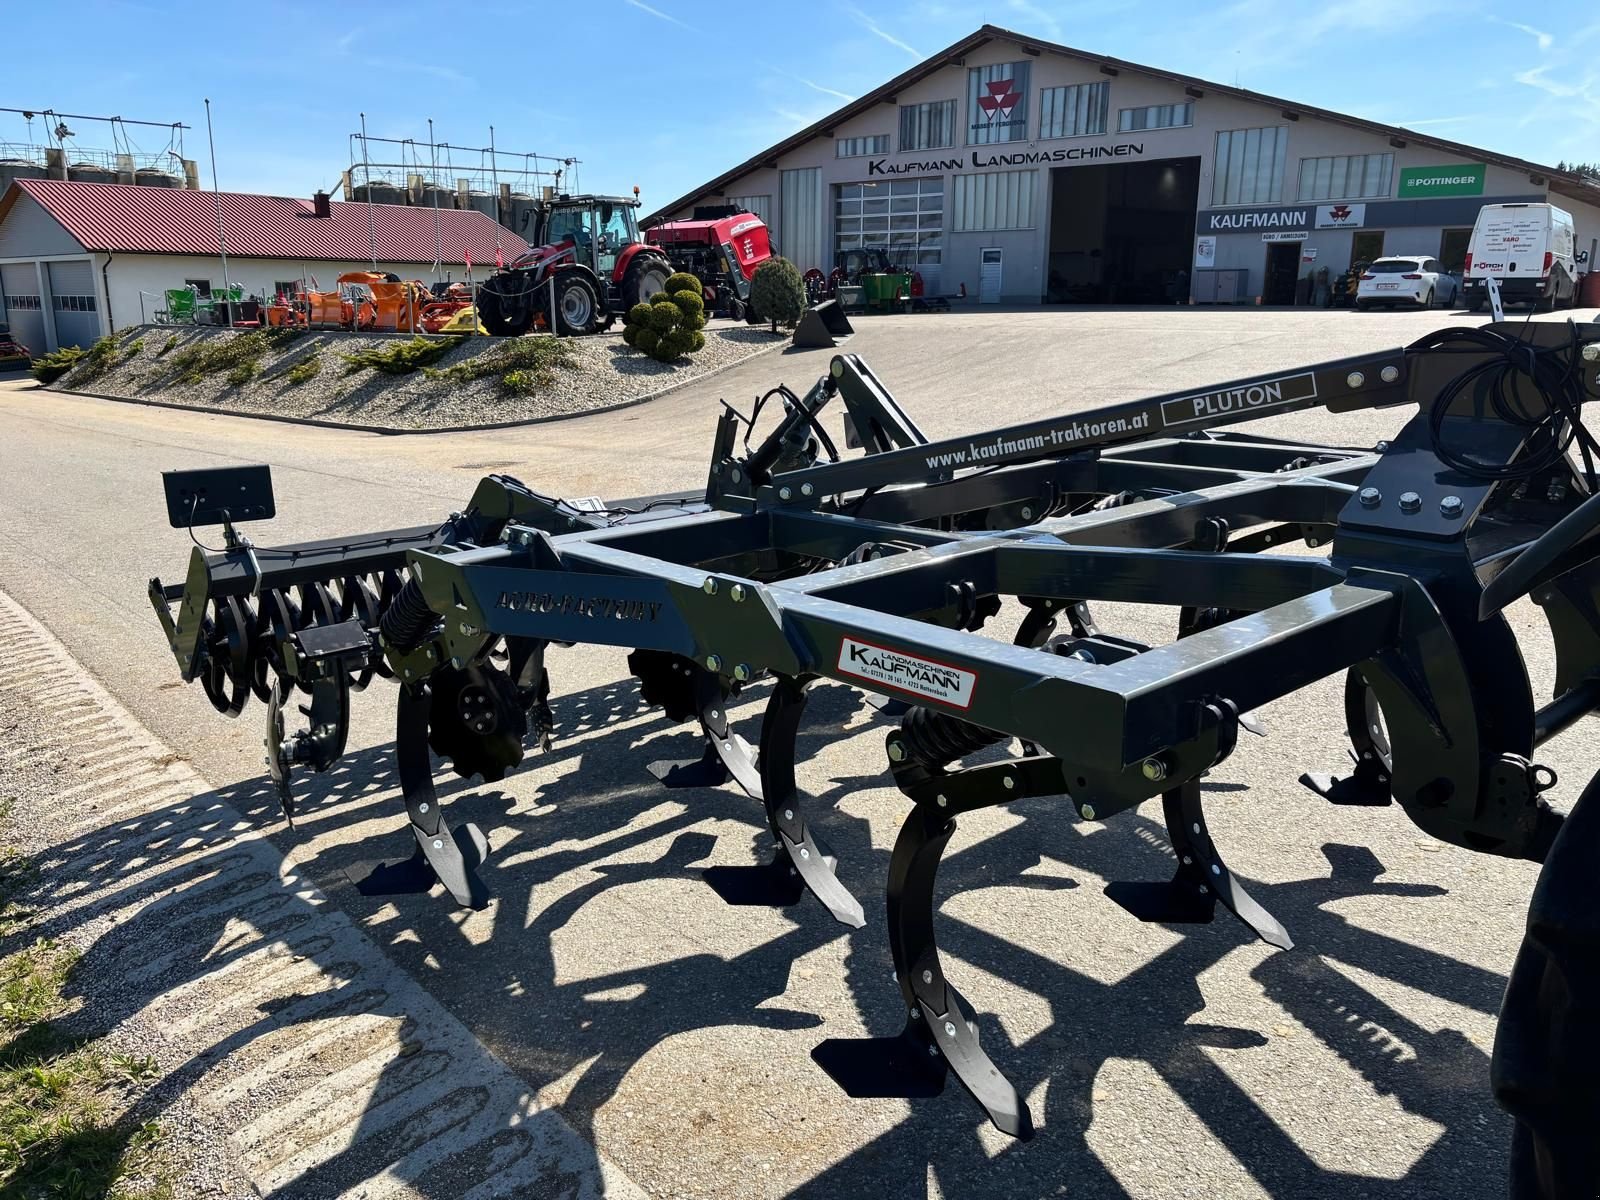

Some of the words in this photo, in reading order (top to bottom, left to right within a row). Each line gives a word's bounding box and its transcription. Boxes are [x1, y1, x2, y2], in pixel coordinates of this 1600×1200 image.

[869, 157, 963, 175] KAUFMANN
[972, 143, 1144, 168] LANDMASCHINEN
[1210, 211, 1307, 229] KAUFMANN
[1193, 382, 1282, 417] PLUTON
[925, 411, 1150, 471] www.kaufmann-traktoren.at
[495, 591, 663, 622] AGRO-FACTORY
[850, 644, 960, 692] KAUFMANN
[881, 652, 960, 680] LANDMASCHINEN
[907, 680, 919, 689] 4723
